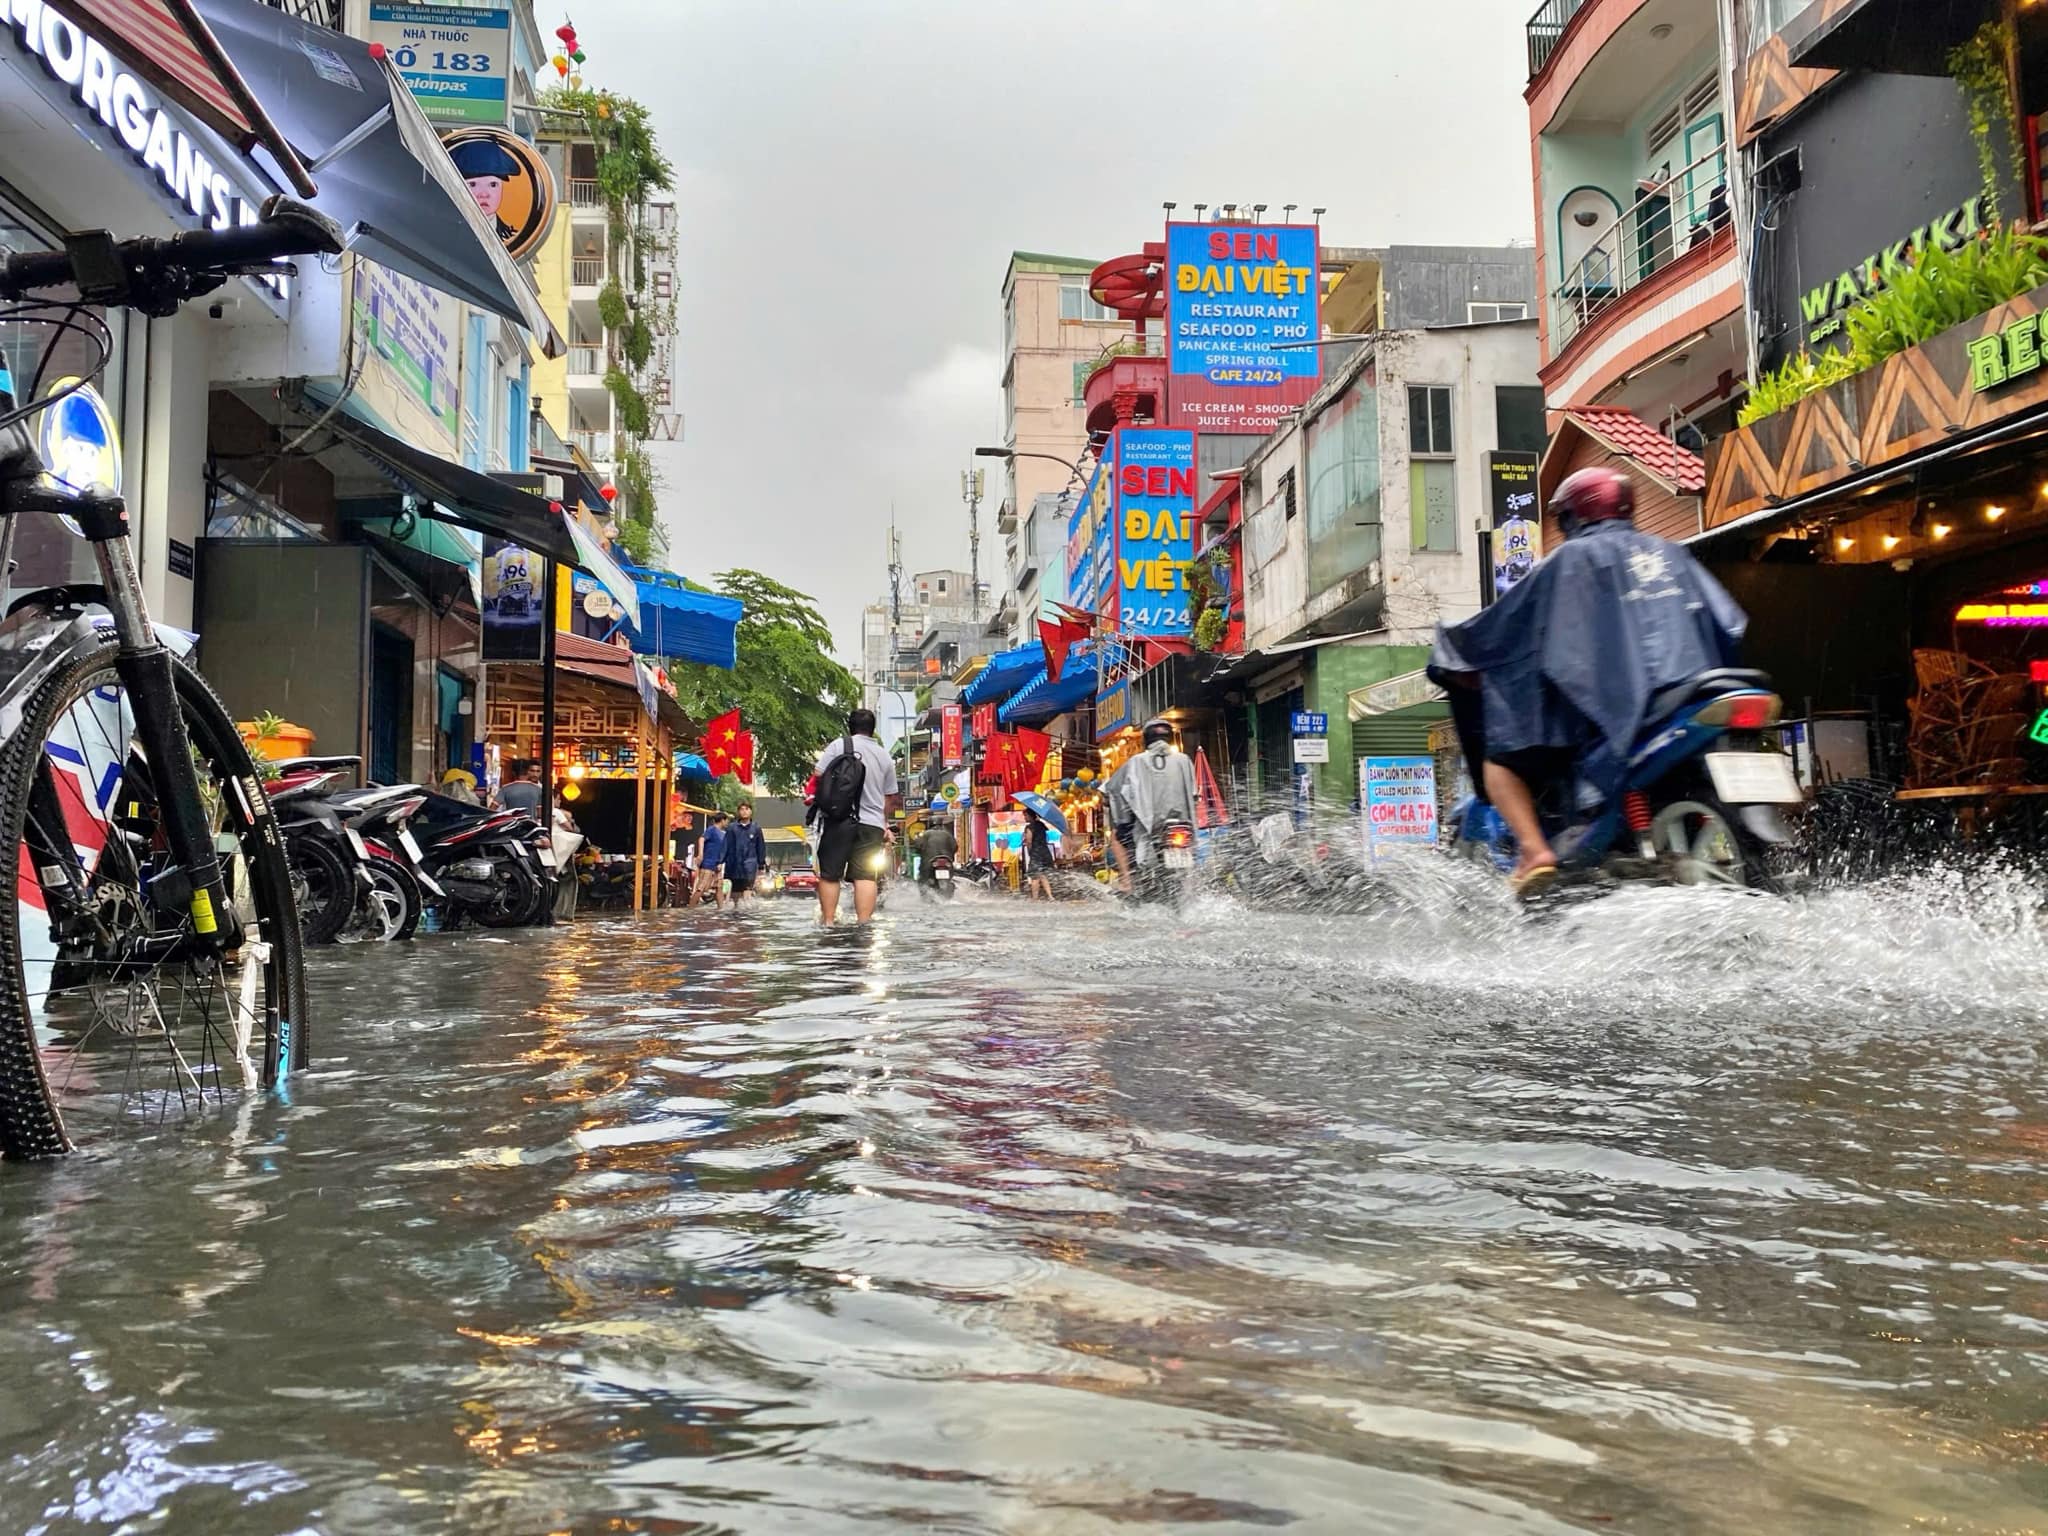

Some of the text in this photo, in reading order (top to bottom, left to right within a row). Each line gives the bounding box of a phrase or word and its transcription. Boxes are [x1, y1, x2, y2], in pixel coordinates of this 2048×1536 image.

[403, 28, 470, 42] NHÀ THUỐC
[432, 51, 490, 72] 183
[1208, 231, 1278, 260] SEN
[1800, 197, 1984, 323] WAIKIKI
[1176, 258, 1312, 300] ĐẠI VIỆT
[1191, 304, 1300, 319] RESTAURANT
[1179, 323, 1257, 337] SEAFOOD
[1809, 319, 1841, 344] BAR
[1205, 354, 1289, 367] SPRING ROLL
[1210, 369, 1283, 384] CAFE 24/24
[1181, 402, 1201, 413] ICE
[1204, 403, 1245, 413] CREAM
[1125, 443, 1167, 451] SEAFOOD
[1121, 465, 1193, 497] SEN
[1124, 508, 1191, 546] ĐẠI
[1118, 551, 1192, 598] VIỆT
[1121, 607, 1192, 627] 24/24
[1397, 786, 1412, 796] MEAT
[1417, 803, 1434, 822] TA
